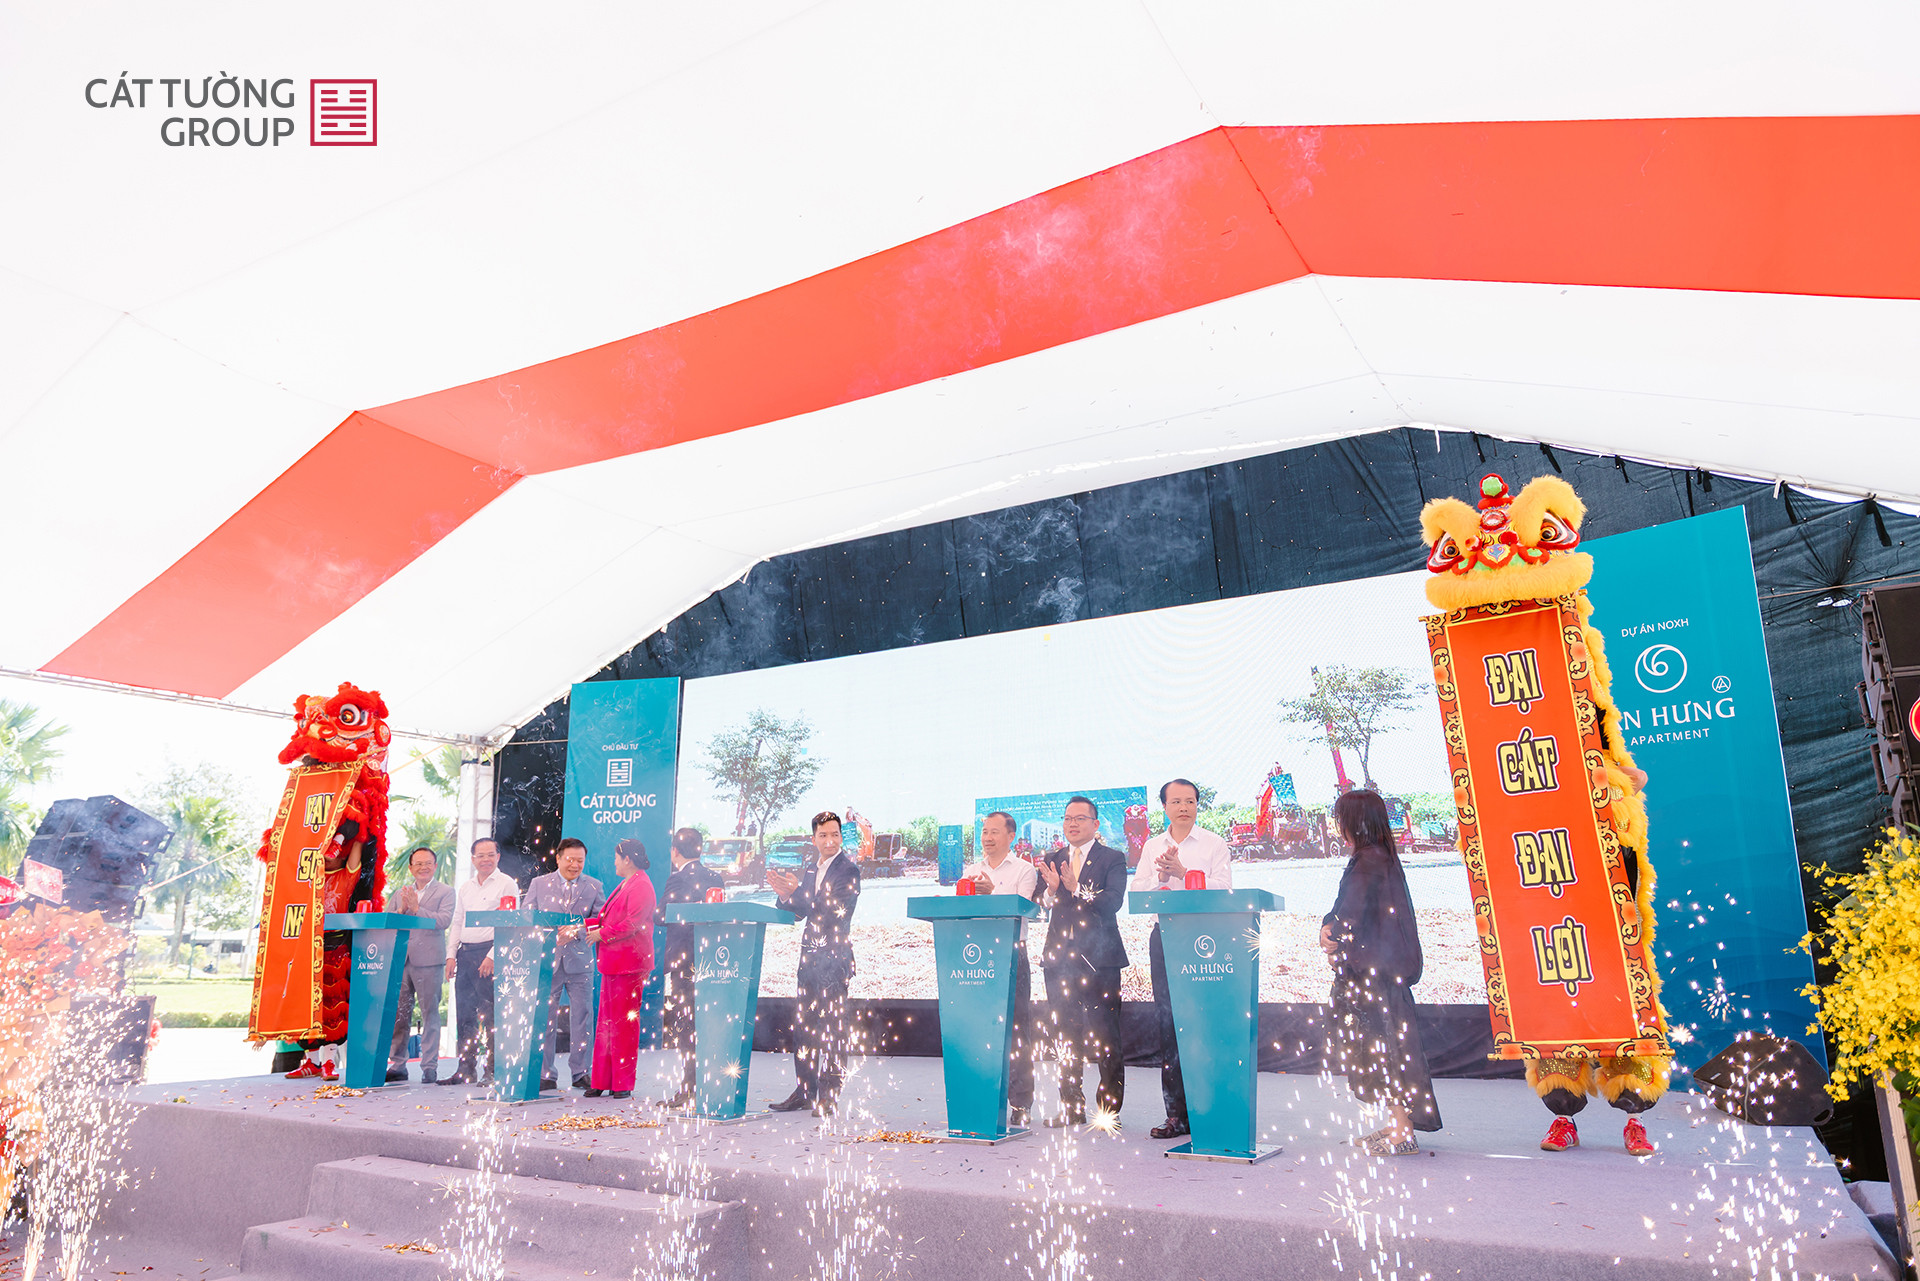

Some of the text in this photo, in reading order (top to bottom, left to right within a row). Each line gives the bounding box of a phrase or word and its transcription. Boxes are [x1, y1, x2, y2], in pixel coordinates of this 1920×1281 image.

[1621, 618, 1690, 638] DỰ ÁN NOXH
[1483, 648, 1545, 715] ĐẠI
[1651, 697, 1736, 727] HƯNG
[1630, 728, 1710, 746] APARTMENT
[1496, 726, 1560, 796] CÁT
[580, 791, 657, 809] CÁT TƯỜNG
[593, 810, 642, 824] GROUP
[1513, 827, 1579, 899] ĐẠI
[1530, 915, 1594, 997] LỢI
[950, 968, 995, 979] AN HƯNG
[1181, 962, 1234, 974] AN HƯNG
